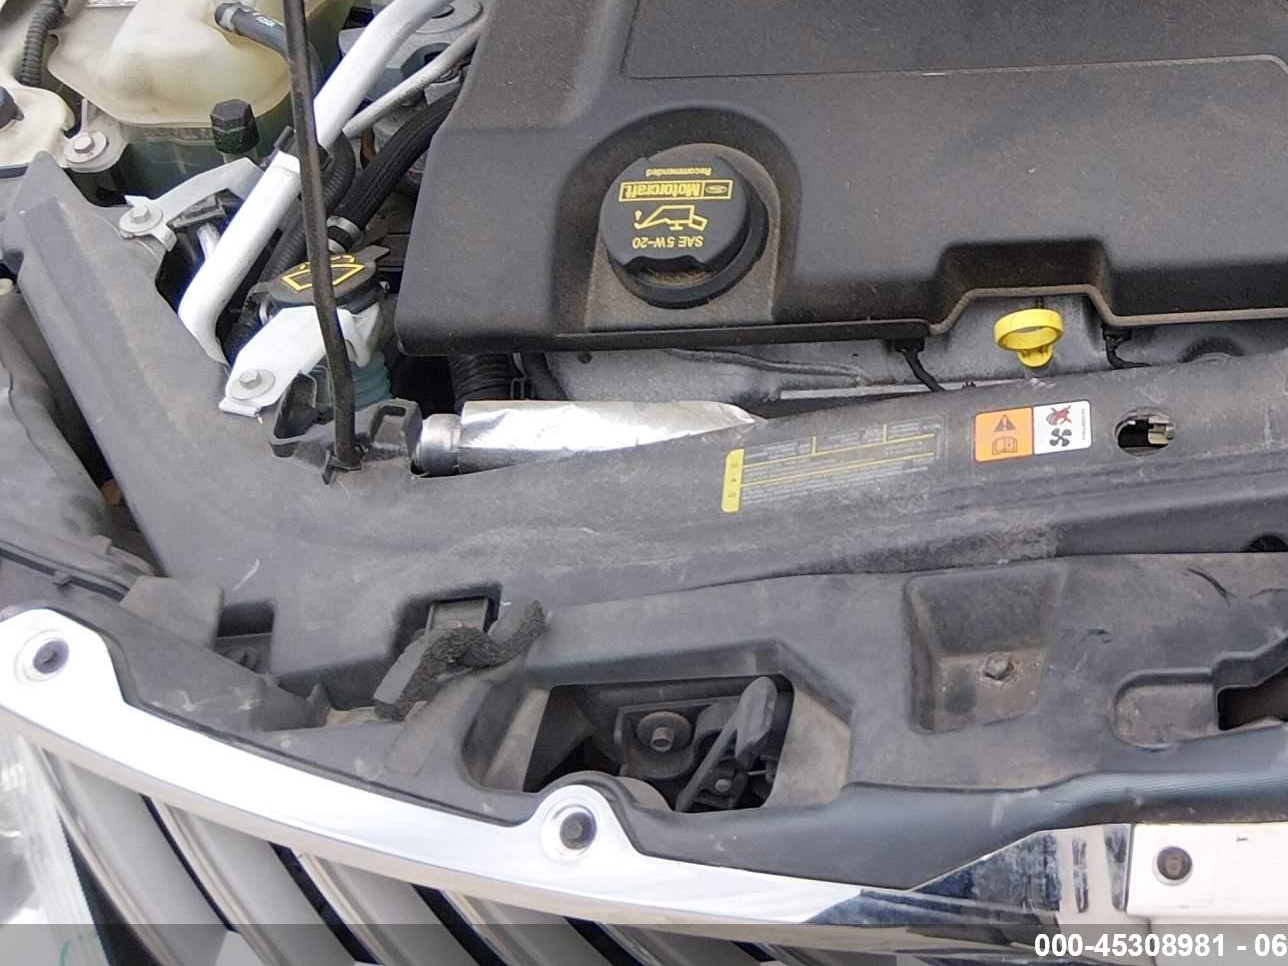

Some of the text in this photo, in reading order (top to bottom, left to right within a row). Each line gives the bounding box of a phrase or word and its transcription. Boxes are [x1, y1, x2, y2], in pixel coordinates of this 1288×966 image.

[646, 167, 712, 177] Recommended
[624, 182, 701, 198] Motorcraft
[678, 235, 704, 248] SAE
